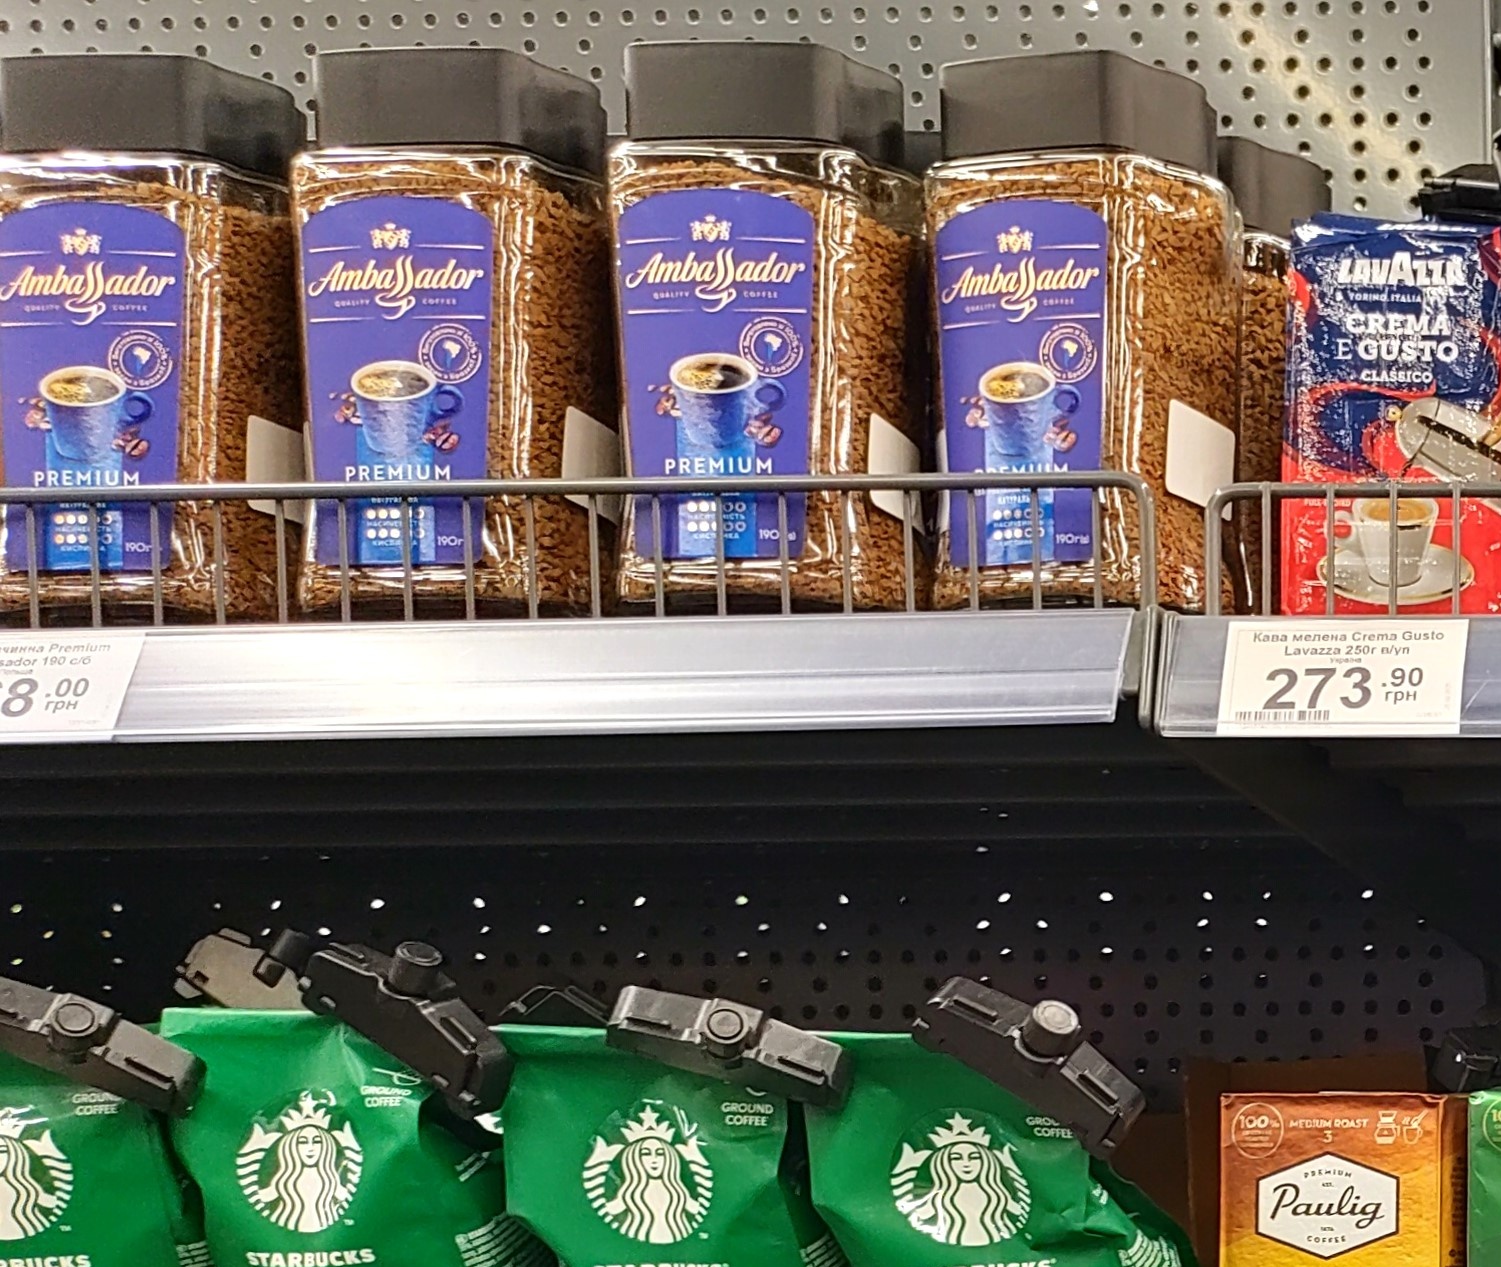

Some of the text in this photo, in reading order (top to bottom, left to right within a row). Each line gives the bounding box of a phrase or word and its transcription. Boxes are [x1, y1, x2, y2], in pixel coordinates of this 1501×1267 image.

[308, 256, 484, 298] Ambassador
[625, 248, 806, 289] Ambassador
[1340, 251, 1464, 287] LAVAZZA
[941, 257, 1100, 301] Ambassador
[1346, 314, 1450, 336] CREMA
[1336, 339, 1459, 362] E GUSTO
[1361, 369, 1433, 384] CLASSICO
[346, 465, 451, 481] PREMIUM
[665, 457, 773, 475] PREMIUM
[1253, 629, 1444, 643] Кава мелена Crema Gusto
[1284, 644, 1339, 656] Lavazza
[1263, 668, 1374, 709] 273
[1385, 688, 1417, 703] грн
[721, 1103, 773, 1115] GROUND
[725, 1115, 768, 1126] COFFEE
[1289, 1118, 1368, 1128] MEDIUM ROAST
[1271, 1183, 1384, 1228] Paulig
[247, 1249, 376, 1267] STARBUCKS
